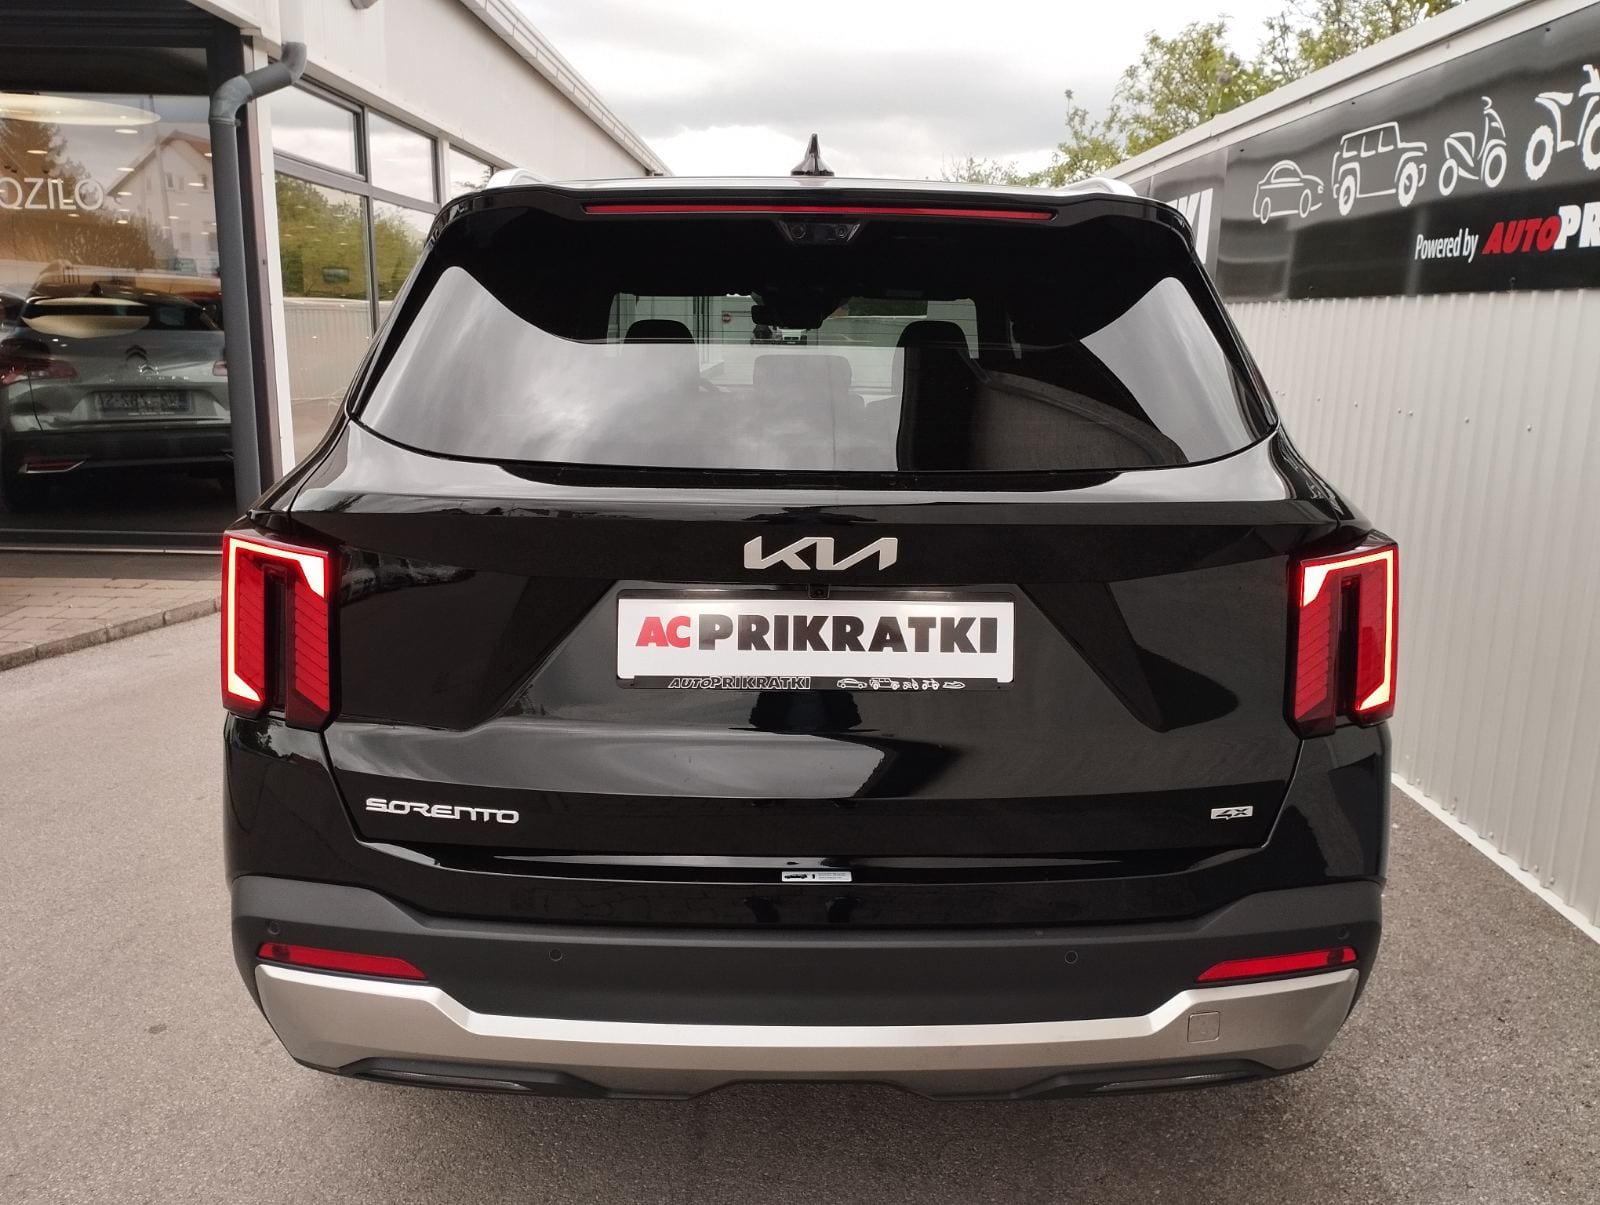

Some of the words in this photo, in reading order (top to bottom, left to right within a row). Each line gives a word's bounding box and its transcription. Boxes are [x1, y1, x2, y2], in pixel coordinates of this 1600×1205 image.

[1414, 228, 1463, 260] Powered
[1464, 227, 1479, 263] by
[744, 536, 898, 571] KIA
[668, 676, 811, 690] AUTOPRIKRATKI
[365, 797, 520, 824] SORENTO
